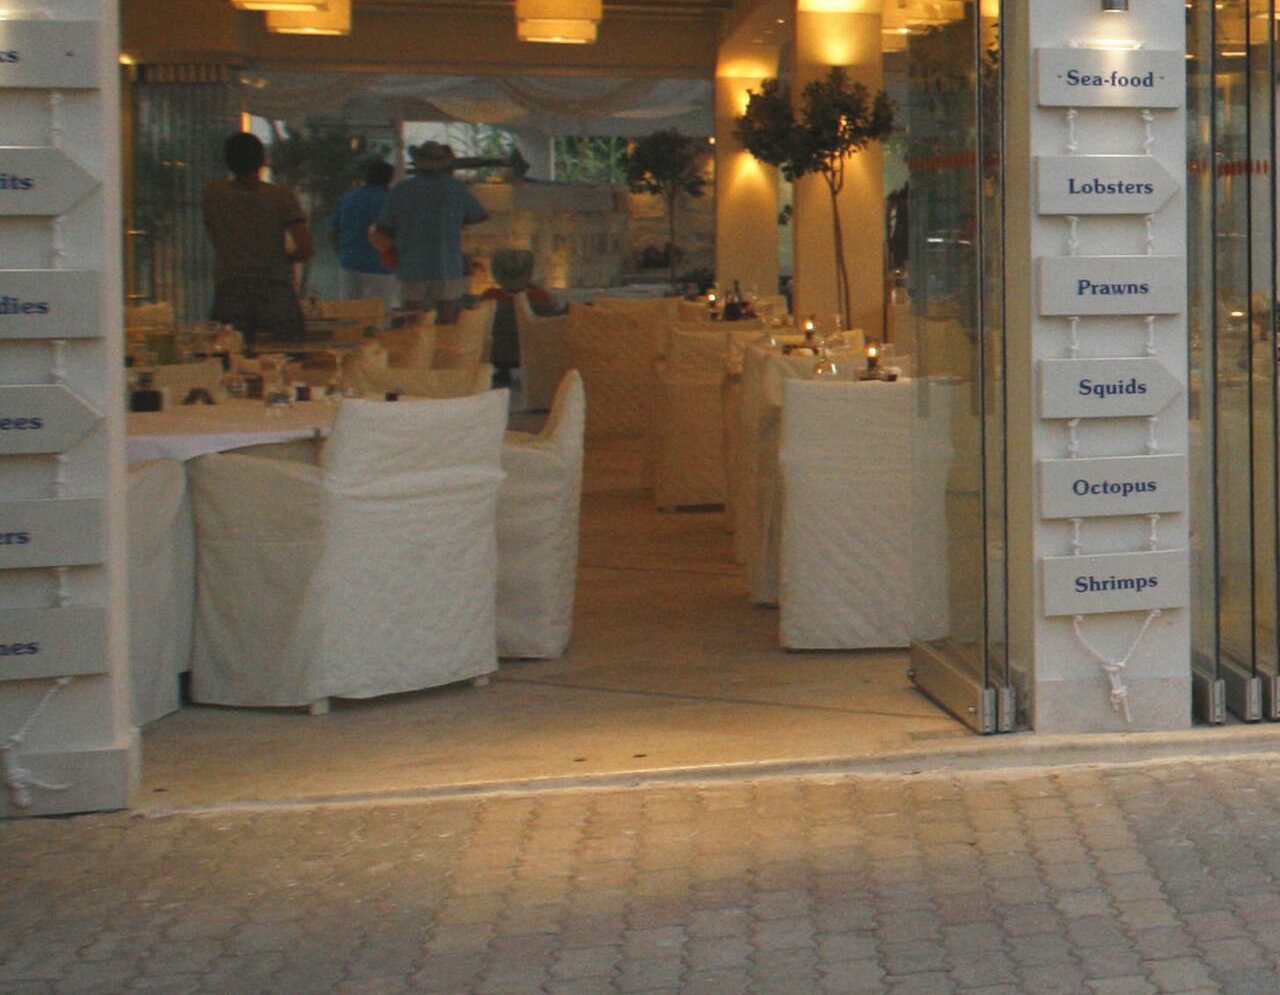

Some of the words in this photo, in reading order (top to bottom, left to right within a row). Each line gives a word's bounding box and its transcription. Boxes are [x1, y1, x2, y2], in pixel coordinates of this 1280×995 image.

[1066, 69, 1154, 88] Sea-food
[1068, 178, 1153, 195] Lobsters
[1077, 279, 1149, 296] Prawns
[1078, 378, 1147, 398] Squids
[1072, 478, 1157, 497] Octopus
[1074, 574, 1158, 593] Shrimps
